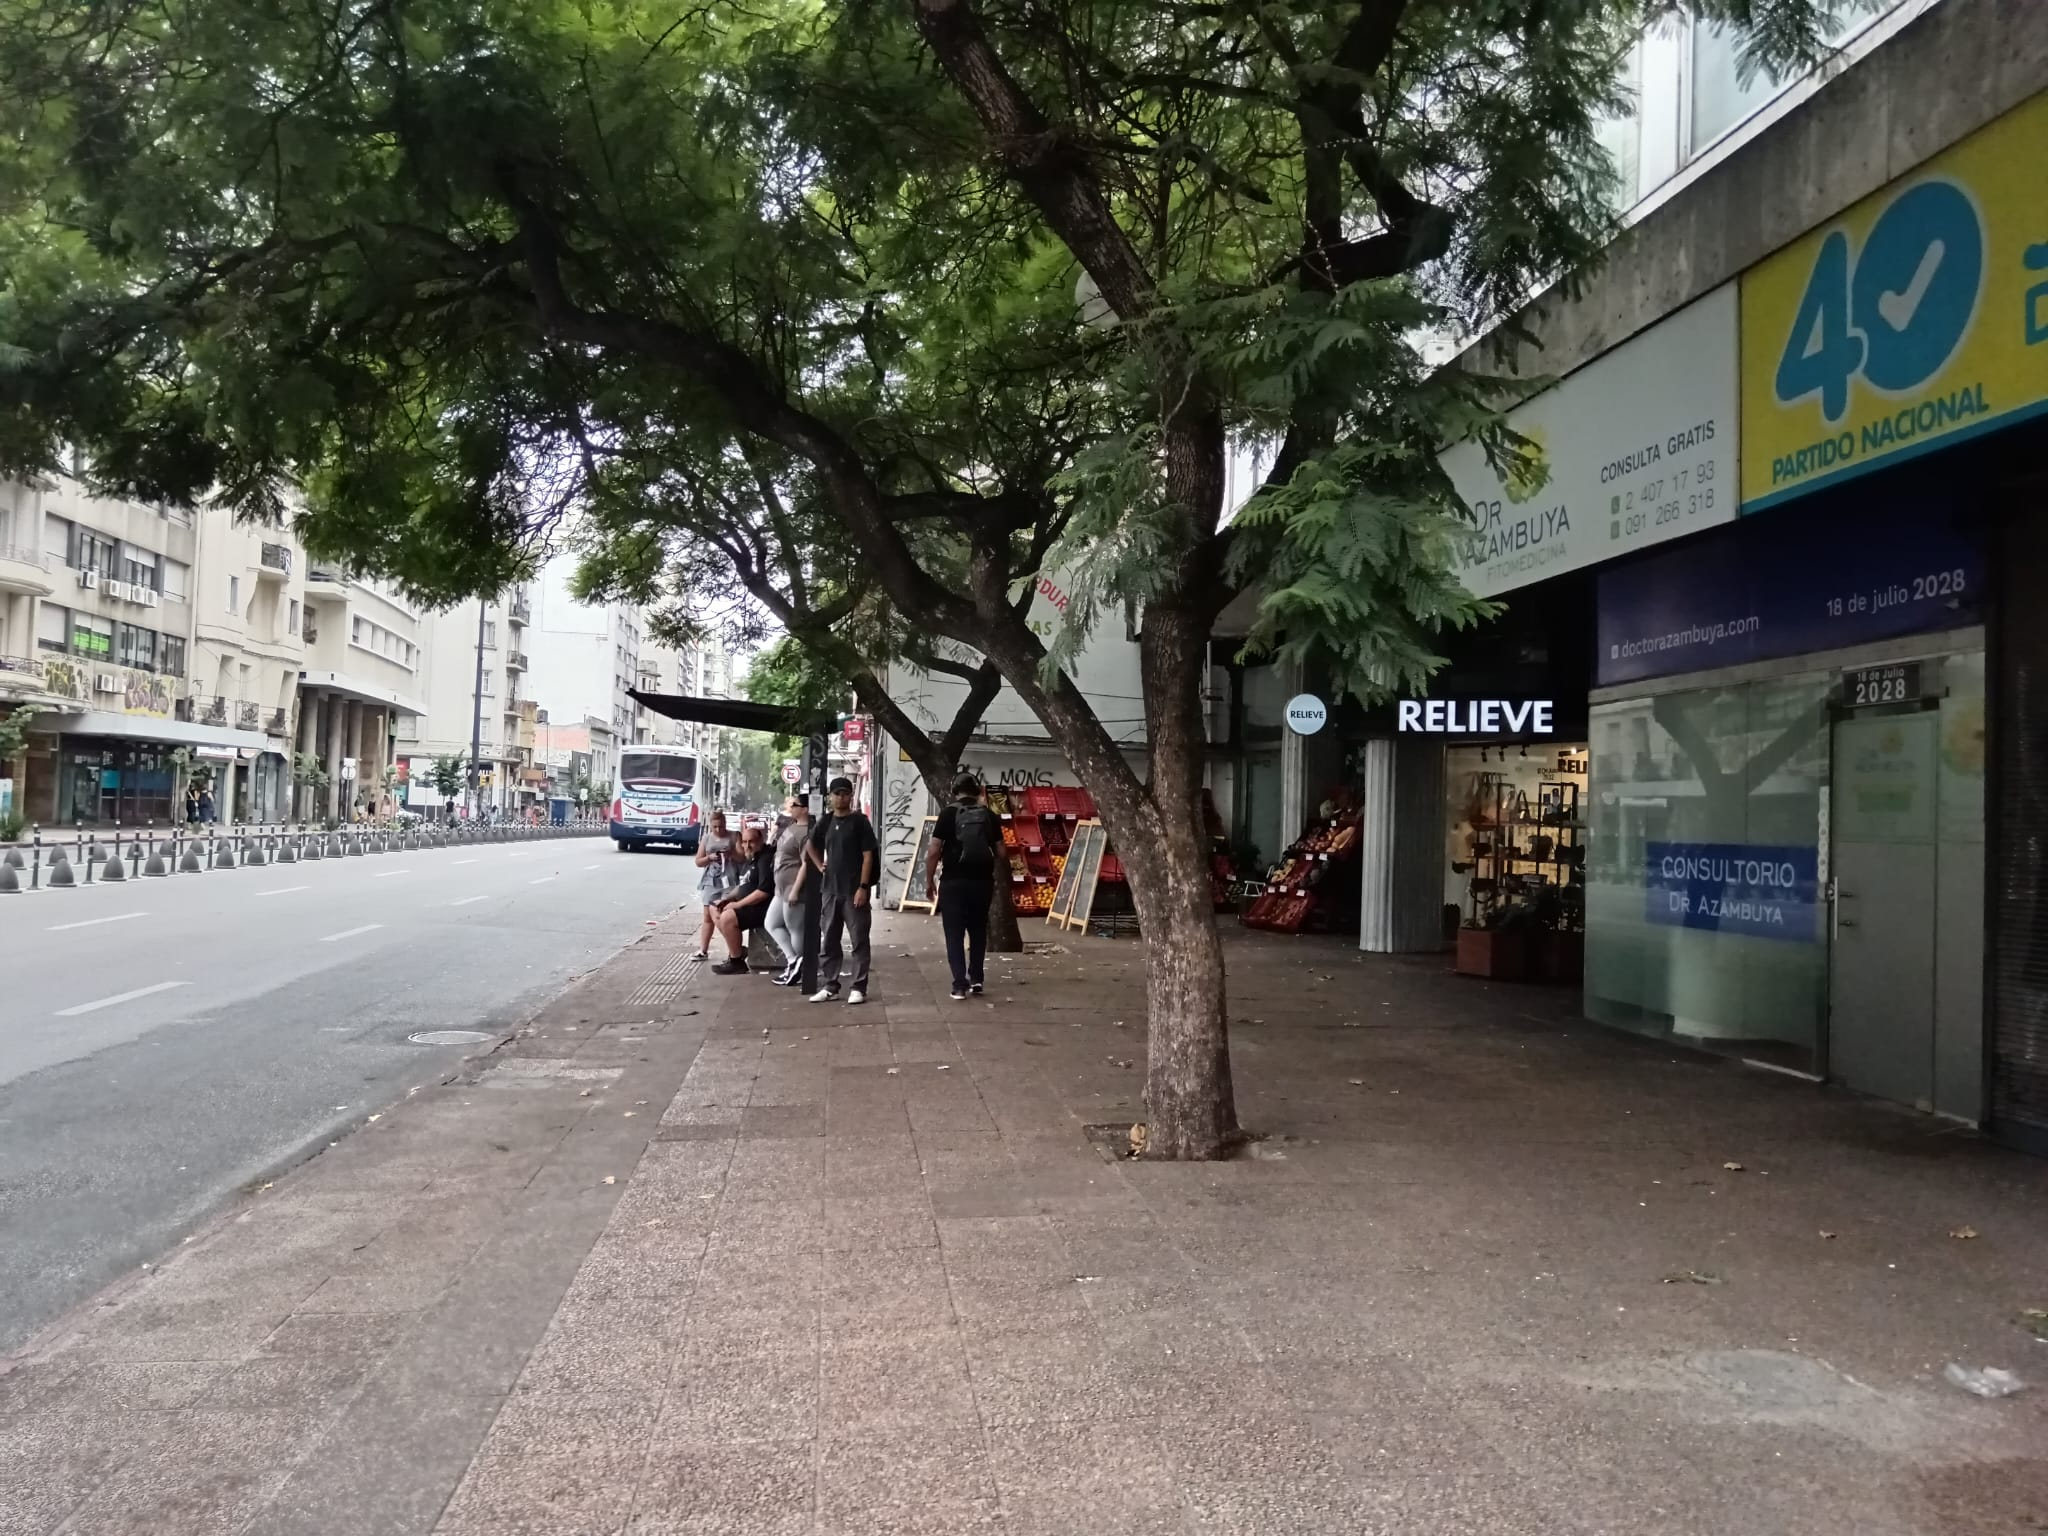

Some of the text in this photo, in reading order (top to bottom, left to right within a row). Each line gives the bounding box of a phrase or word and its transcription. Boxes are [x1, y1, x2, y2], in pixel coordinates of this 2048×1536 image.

[1774, 180, 1984, 423] 40
[1601, 419, 1716, 484] CONSULTA GRATIS
[1772, 382, 1990, 485] PARTIDO NACIONAL
[1625, 460, 1715, 511] 2 407 17 93
[1475, 500, 1502, 534] DR
[1625, 488, 1715, 536] 091 266 318
[1463, 504, 1571, 570] AZAMBUYA
[1826, 568, 1966, 617] 18 de julio 2028
[1621, 614, 1760, 658] doctorazambuya.com
[1856, 678, 1905, 704] 2028
[1869, 671, 1880, 681] de
[1882, 667, 1905, 680] Julio
[1290, 710, 1324, 719] RELIEVE
[1399, 700, 1553, 733] RELIEVE
[1557, 758, 1588, 774] RELI
[1662, 856, 1795, 888] CONSULTORIO
[1669, 891, 1784, 925] DR AZAMBUYA
